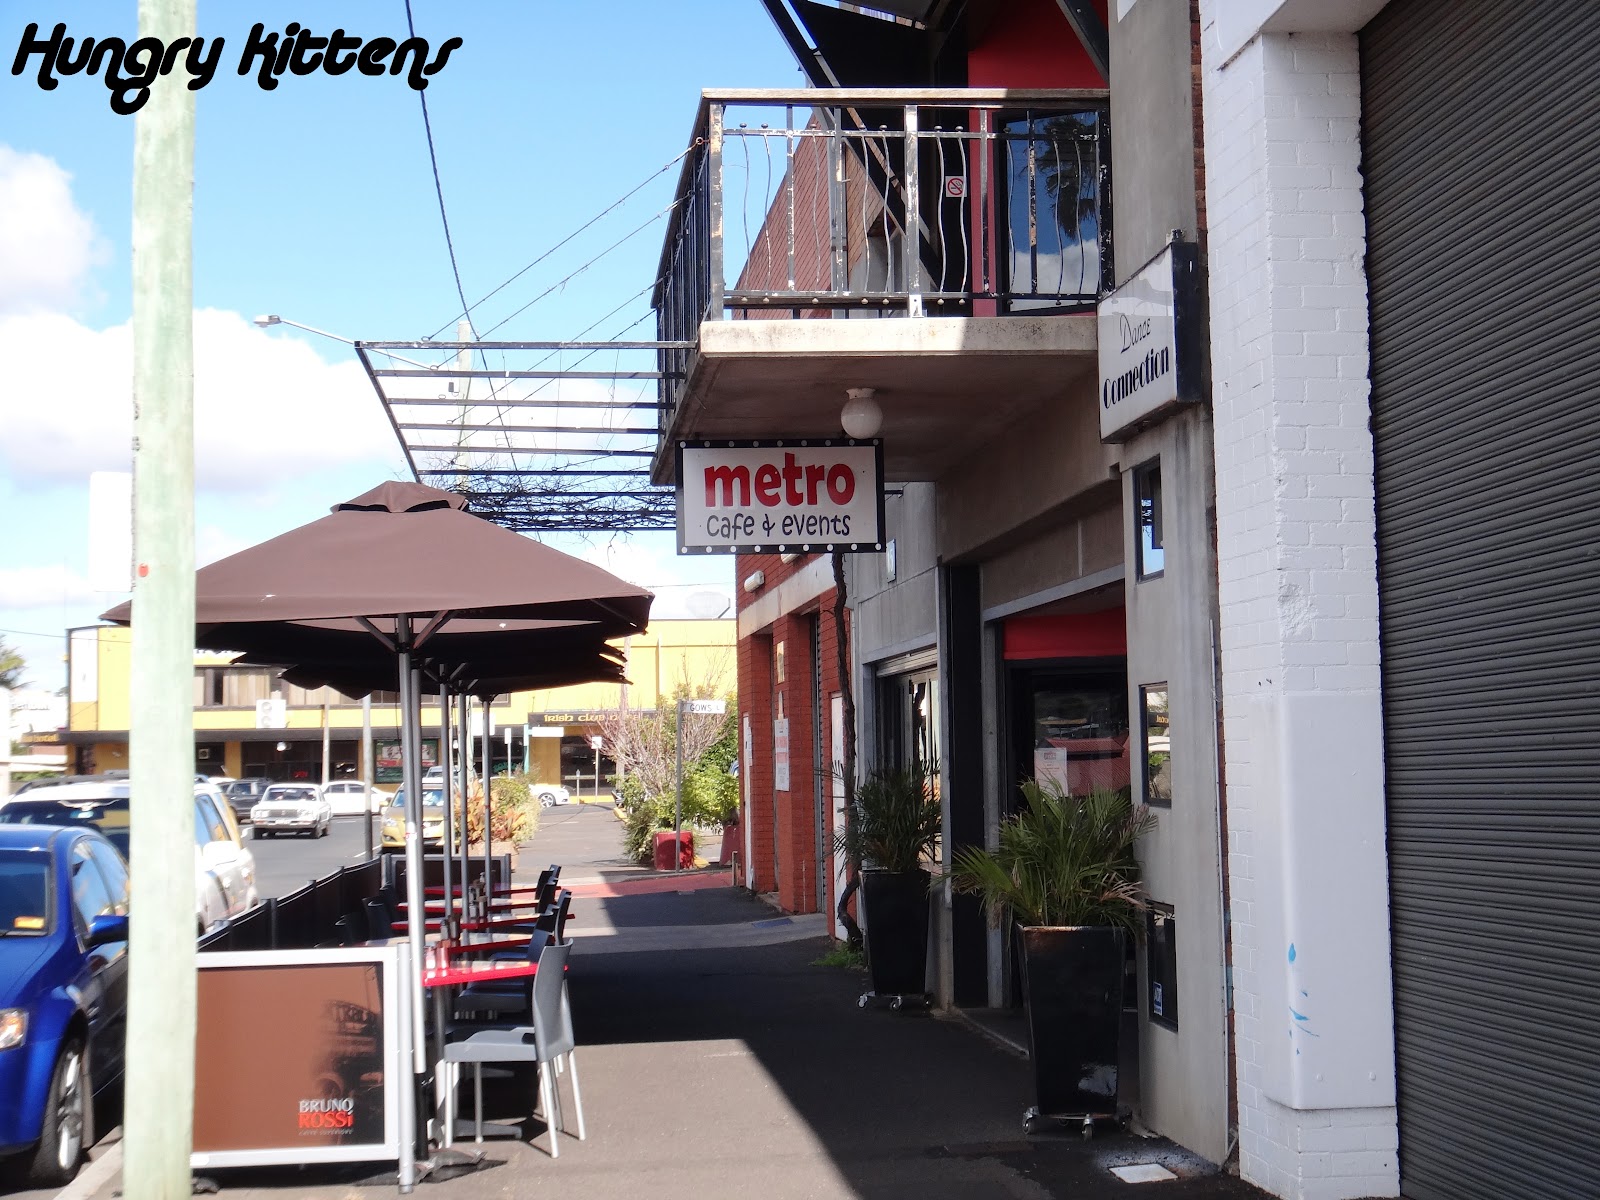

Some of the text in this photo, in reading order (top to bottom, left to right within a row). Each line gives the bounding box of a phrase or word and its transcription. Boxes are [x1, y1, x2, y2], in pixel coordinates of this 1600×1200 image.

[1103, 345, 1170, 409] Connection
[704, 452, 856, 508] metro
[706, 512, 755, 540] cafe
[781, 513, 852, 537] events
[299, 1098, 354, 1113] BRUNO
